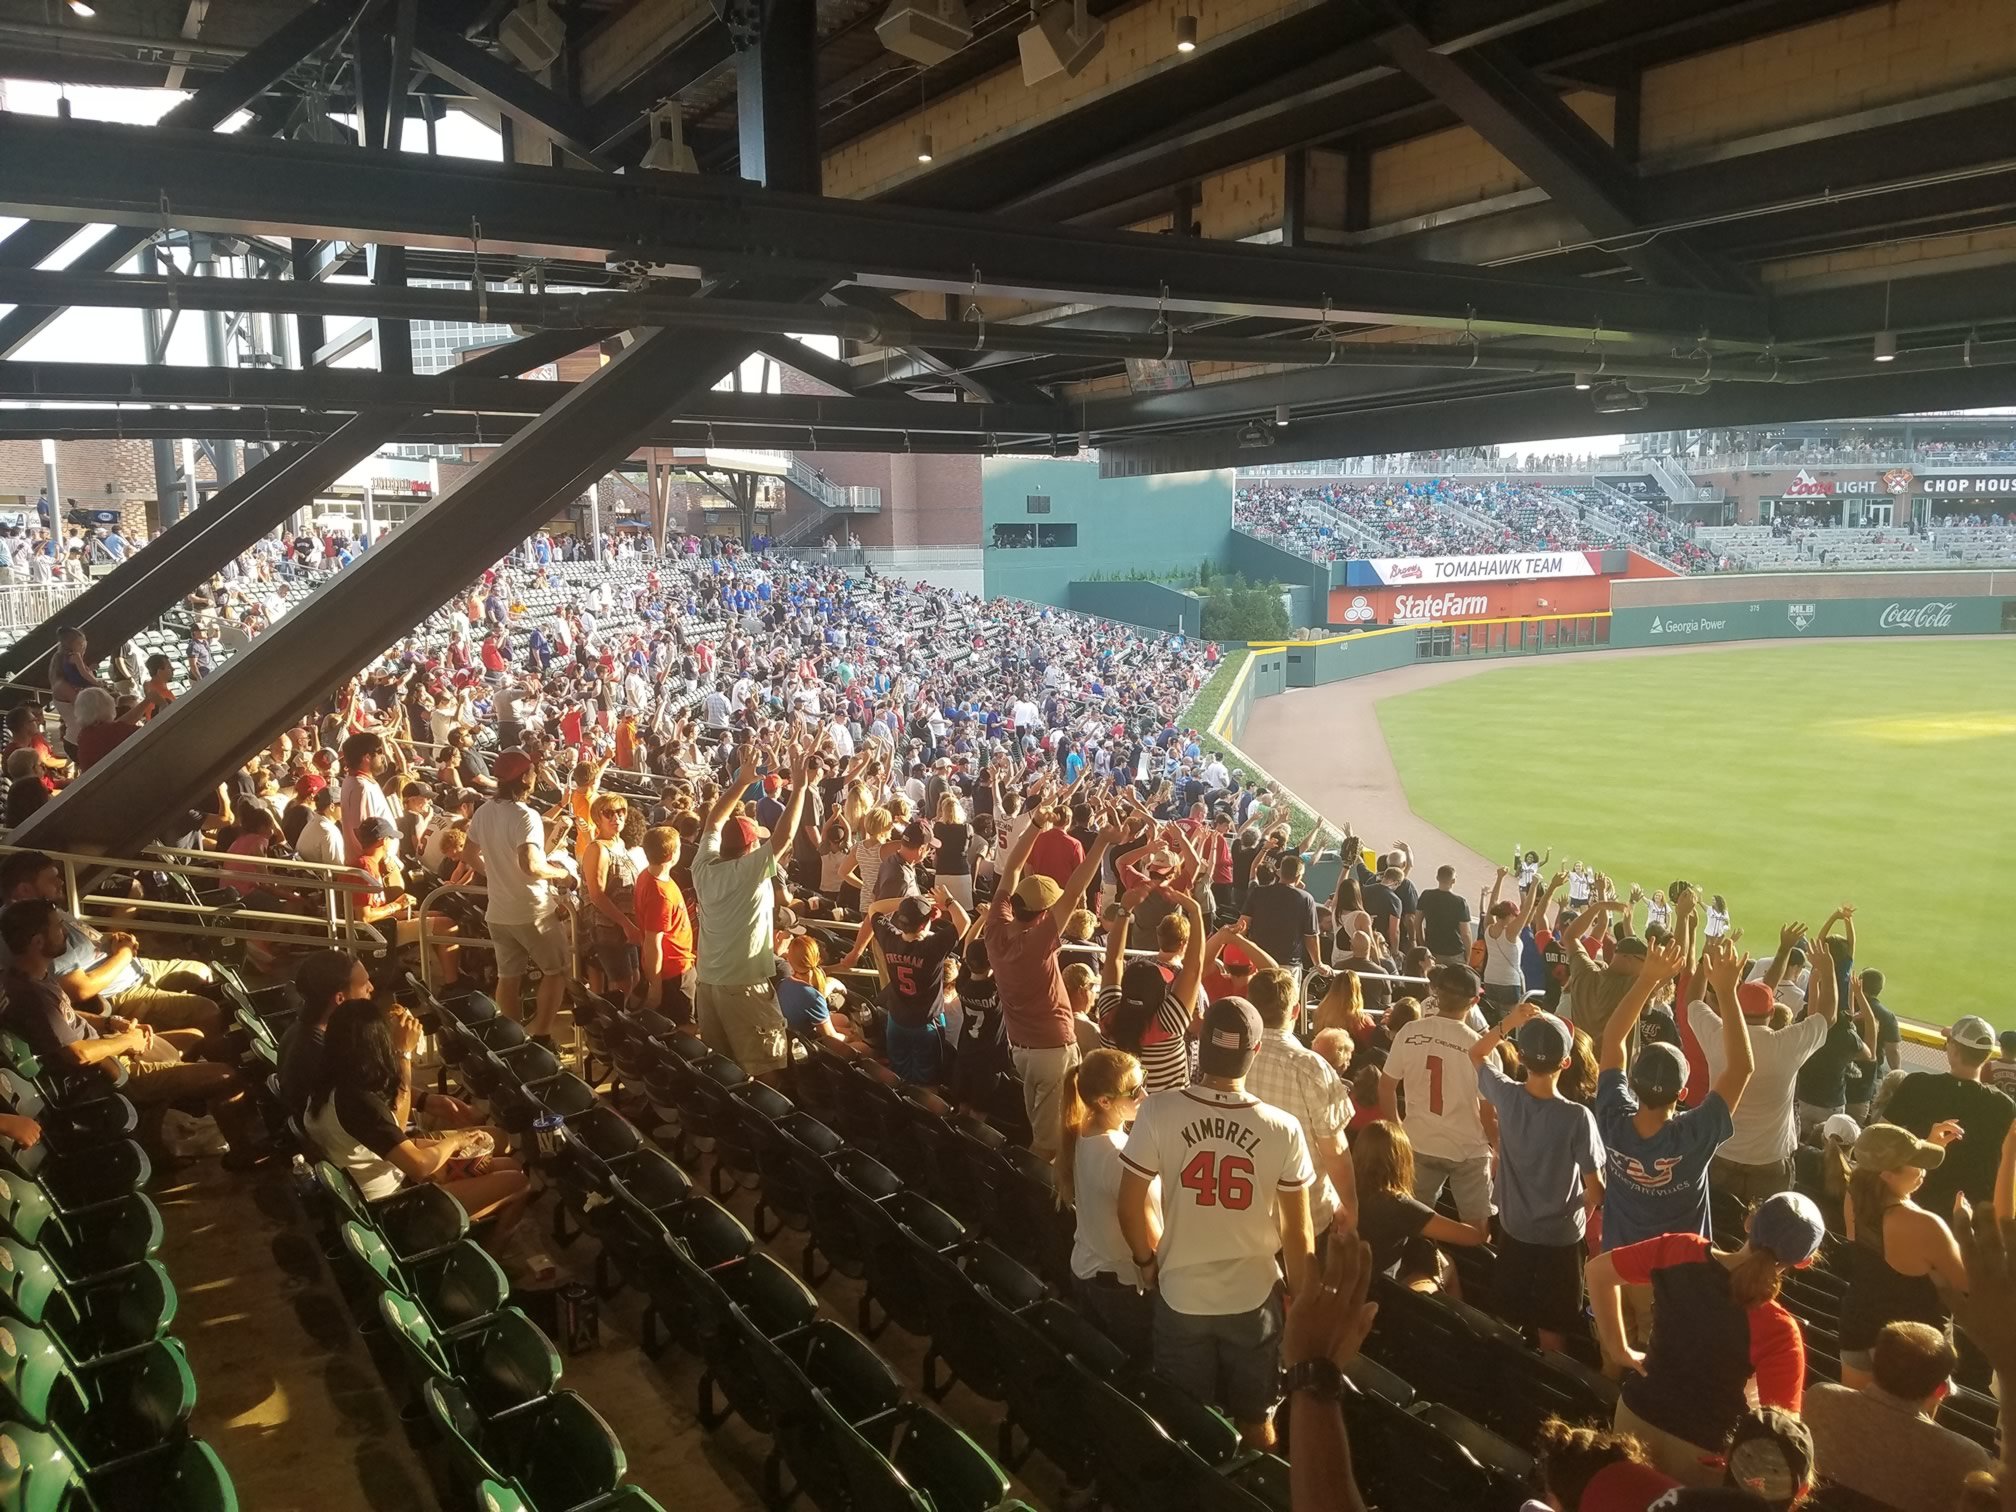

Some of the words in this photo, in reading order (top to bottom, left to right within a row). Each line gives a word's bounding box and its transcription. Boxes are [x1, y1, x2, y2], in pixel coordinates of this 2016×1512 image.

[1786, 477, 1834, 496] Coors
[1835, 481, 1877, 494] LIGHT
[1923, 479, 1969, 493] CHOP
[1435, 559, 1522, 578] TOMAHAWK
[1525, 557, 1562, 573] TEAM
[1790, 605, 1814, 613] MLB
[1880, 602, 1957, 628] Coca-Cola
[1665, 620, 1699, 633] Georgia
[1700, 618, 1727, 631] Power
[886, 953, 924, 969] FREEMAN
[897, 966, 917, 996] 5
[965, 1007, 985, 1039] 7
[1426, 1055, 1444, 1117] 1
[1652, 1085, 1663, 1093] 43
[1181, 1117, 1261, 1159] KIMBREL
[1180, 1150, 1255, 1211] 46
